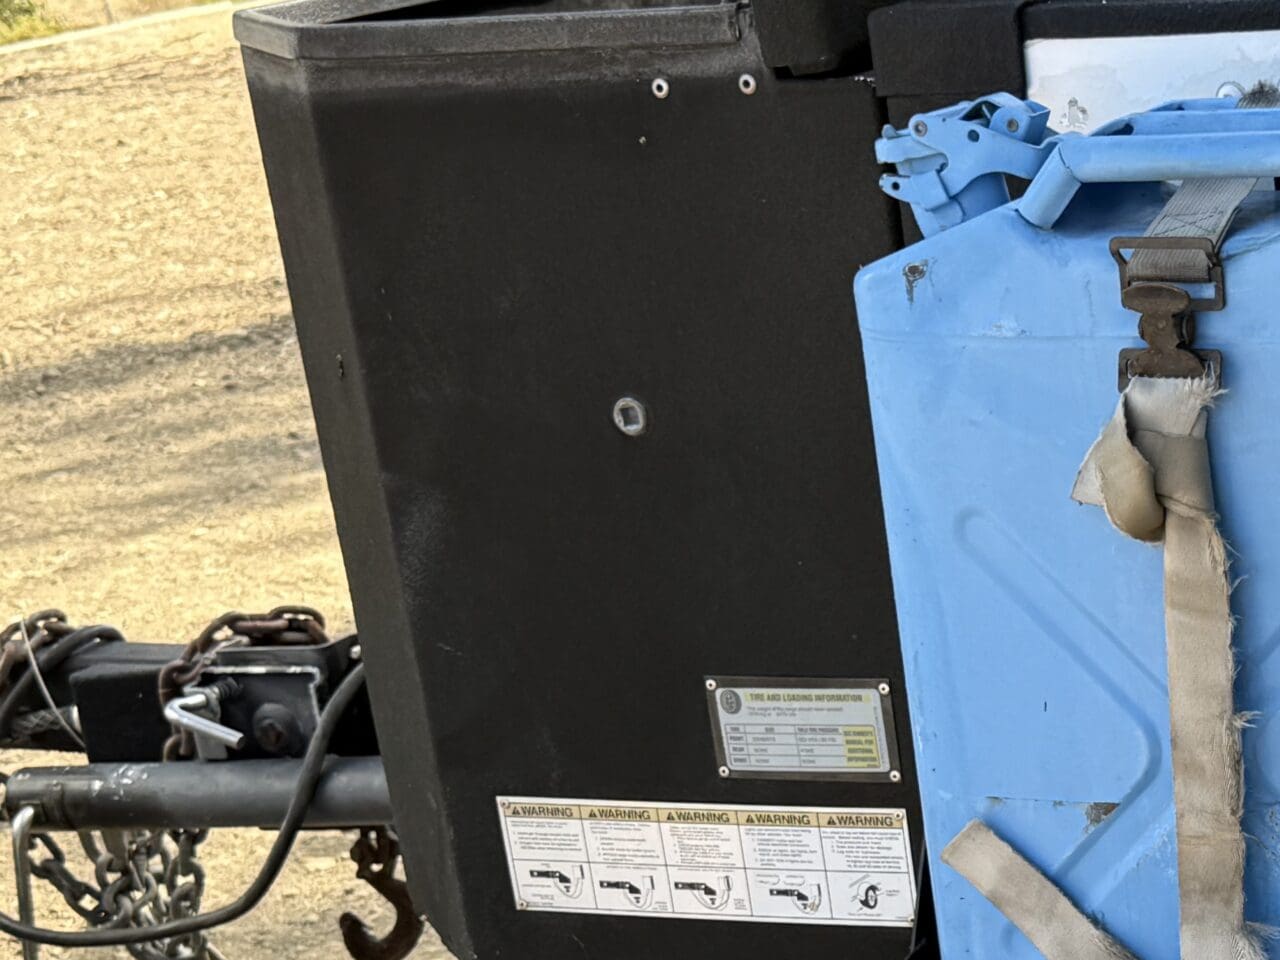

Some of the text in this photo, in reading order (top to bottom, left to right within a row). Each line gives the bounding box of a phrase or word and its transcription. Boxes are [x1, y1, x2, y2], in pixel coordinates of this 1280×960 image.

[520, 806, 573, 818] WARNING
[599, 808, 651, 821] WARNING
[676, 811, 730, 823] WARNING
[754, 813, 811, 826] WARNING
[837, 814, 894, 827] WARNING
